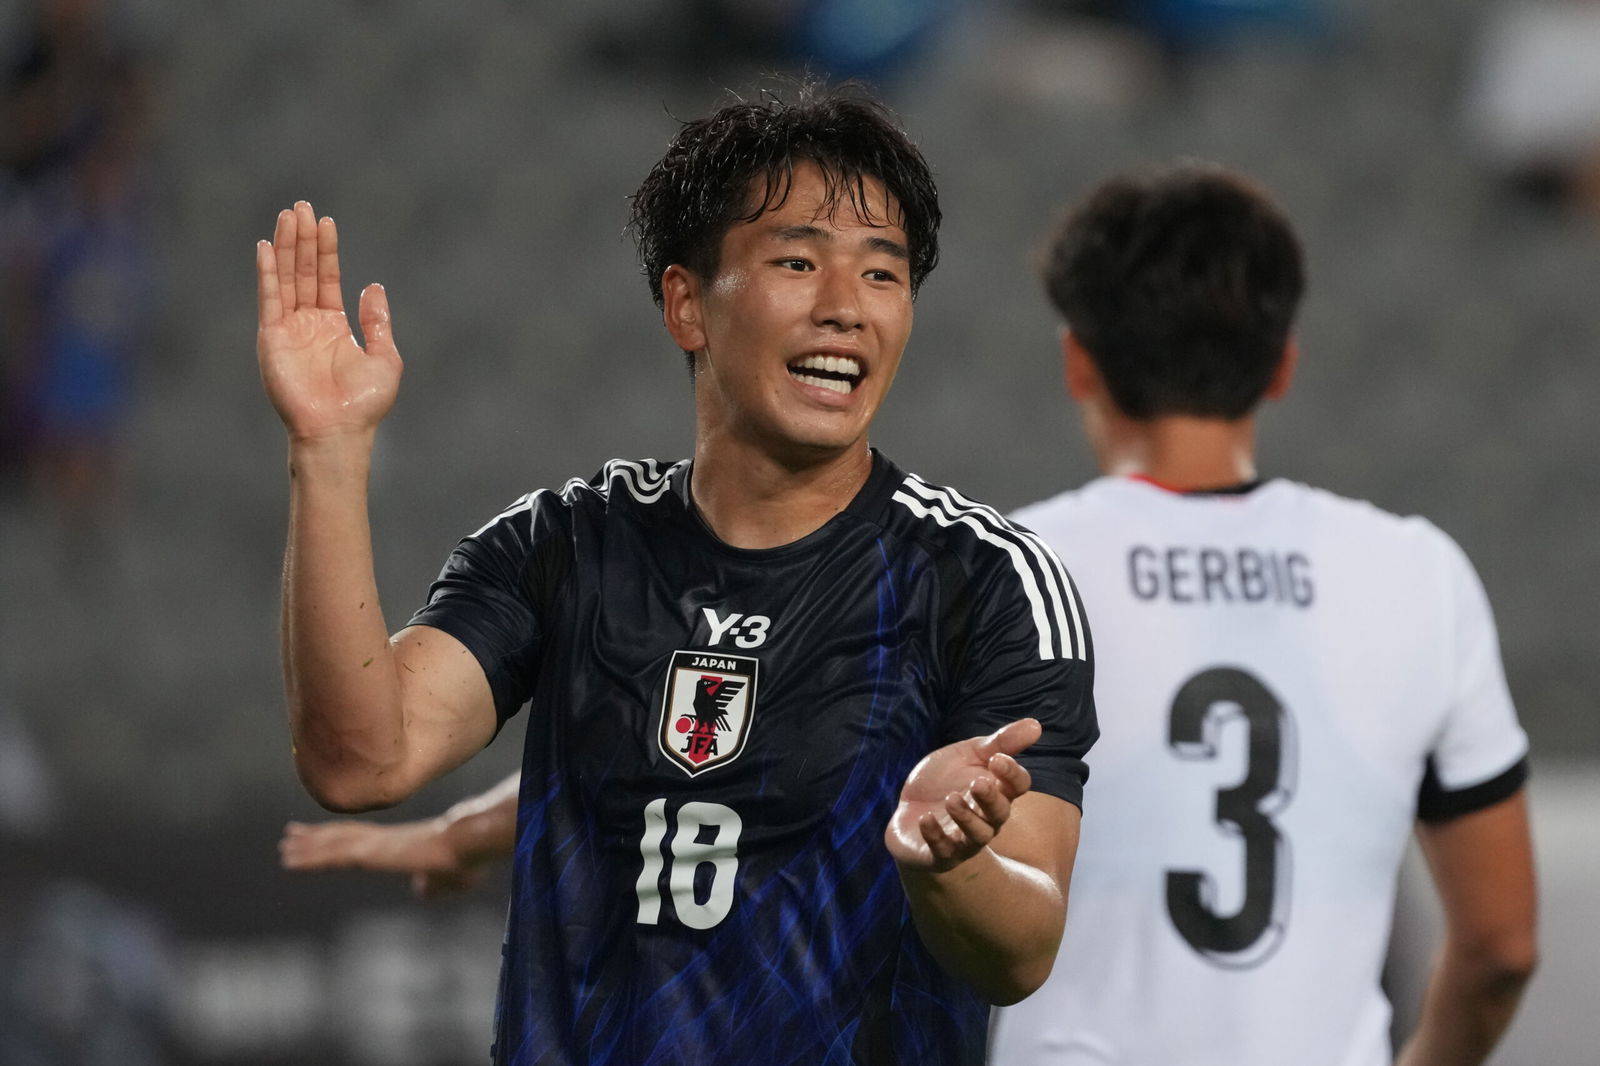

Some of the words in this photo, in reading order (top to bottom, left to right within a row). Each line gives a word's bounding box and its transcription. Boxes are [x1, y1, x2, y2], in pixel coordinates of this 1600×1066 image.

[1128, 547, 1314, 608] GERBIG
[702, 607, 771, 649] Y-3
[691, 656, 737, 671] JAPAN
[680, 733, 718, 756] JFA
[1164, 665, 1298, 971] 3
[635, 798, 743, 930] 18
